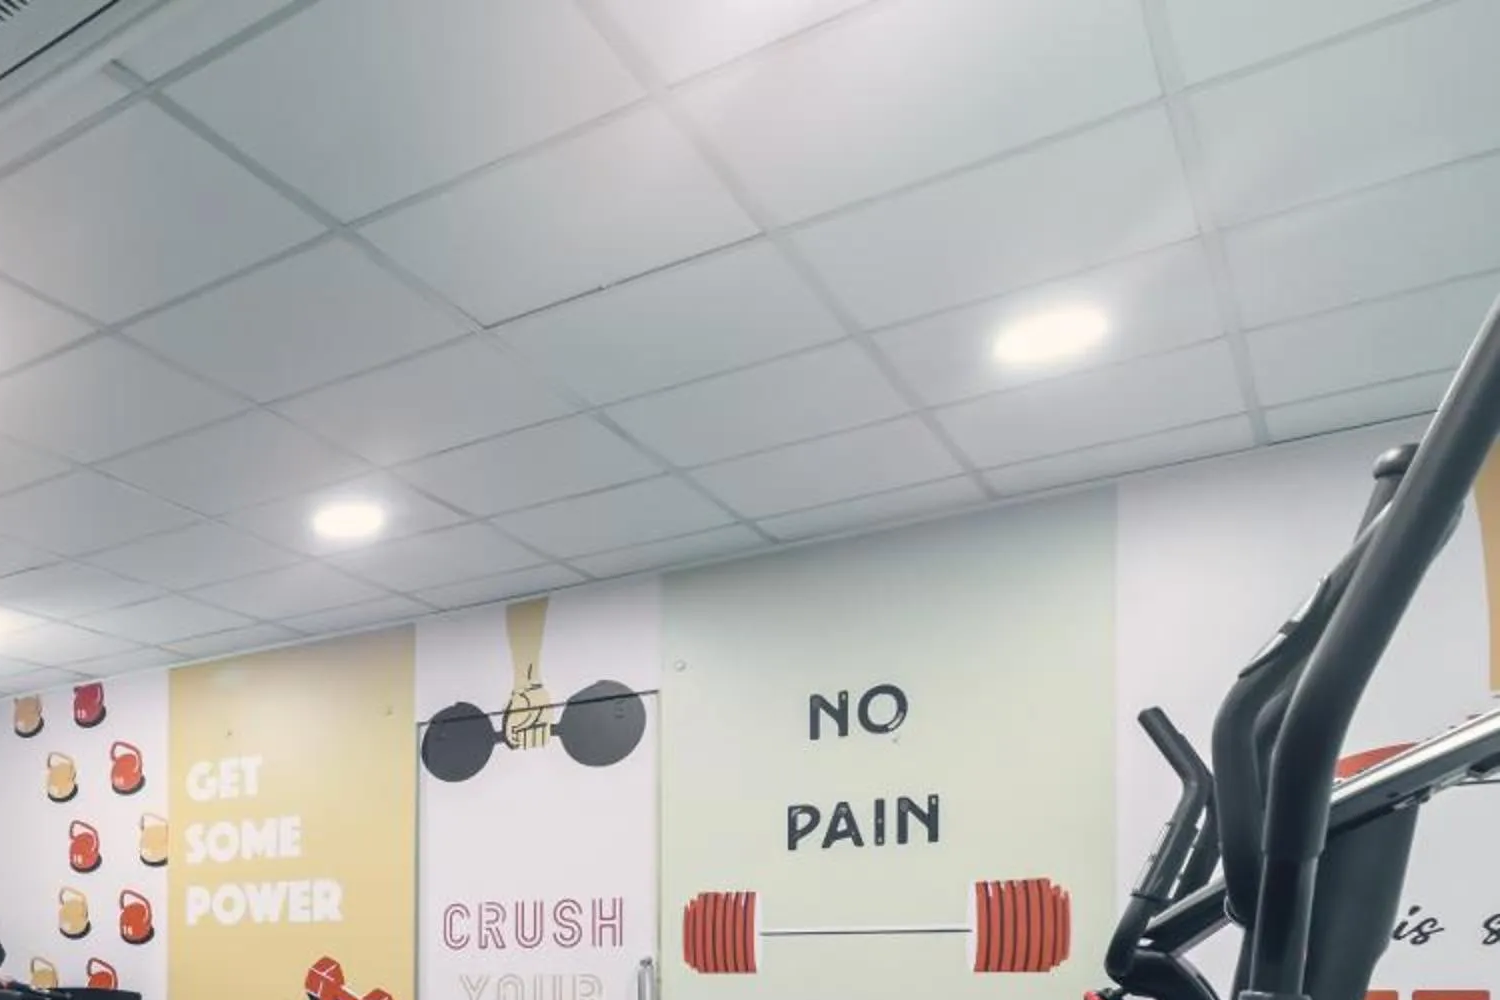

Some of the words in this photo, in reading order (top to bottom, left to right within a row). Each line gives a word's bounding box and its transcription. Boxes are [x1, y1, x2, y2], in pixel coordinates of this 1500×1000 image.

[809, 684, 908, 741] NO
[186, 755, 262, 801] GET
[185, 815, 303, 864] SOME
[787, 794, 940, 851] PAIN
[186, 878, 343, 927] POWER
[443, 897, 623, 949] CRUSH
